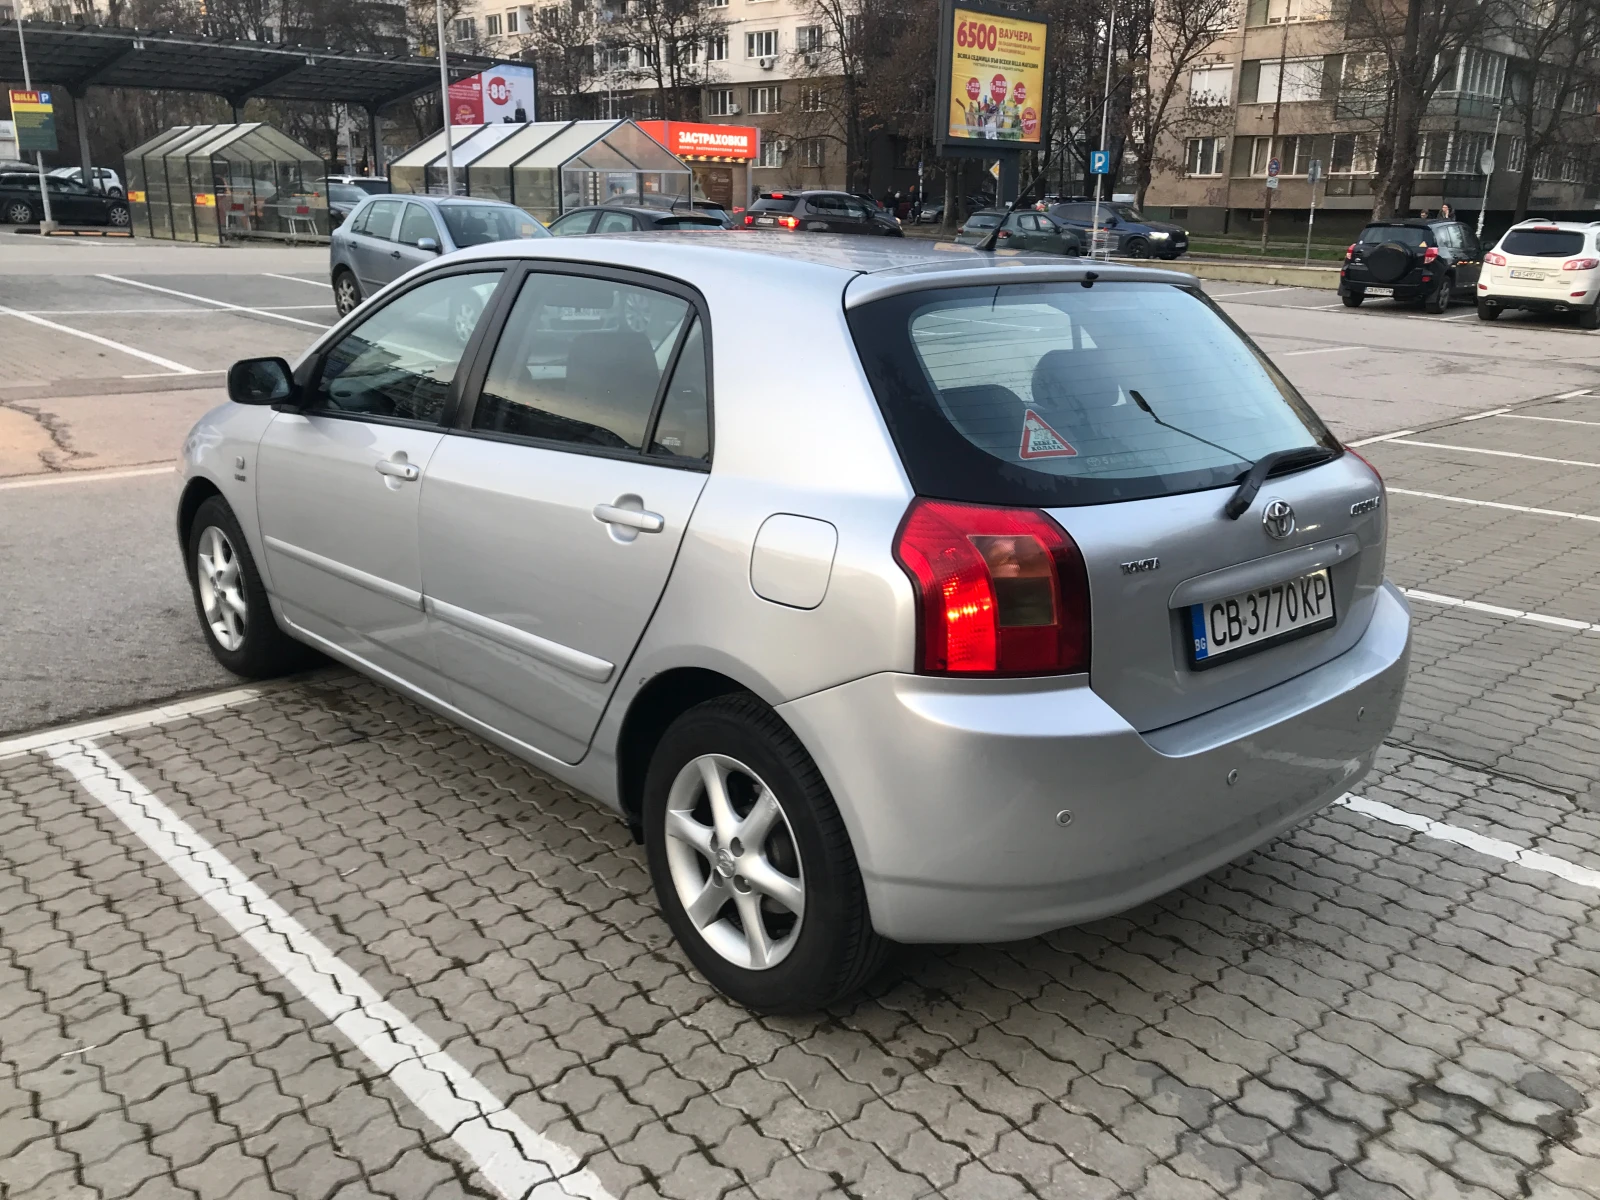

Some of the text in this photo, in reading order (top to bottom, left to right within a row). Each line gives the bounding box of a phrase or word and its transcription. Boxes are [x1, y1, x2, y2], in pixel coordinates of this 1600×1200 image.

[957, 21, 1033, 51] 6500 ВАУЧЕРА
[14, 93, 38, 102] BILLA
[41, 93, 49, 103] P
[678, 131, 748, 147] ЗАСТРАХОВКИ
[1095, 153, 1105, 171] P
[1120, 556, 1160, 575] TOYOTA
[1209, 572, 1327, 647] CB 3770 KP
[1194, 636, 1207, 652] BG
